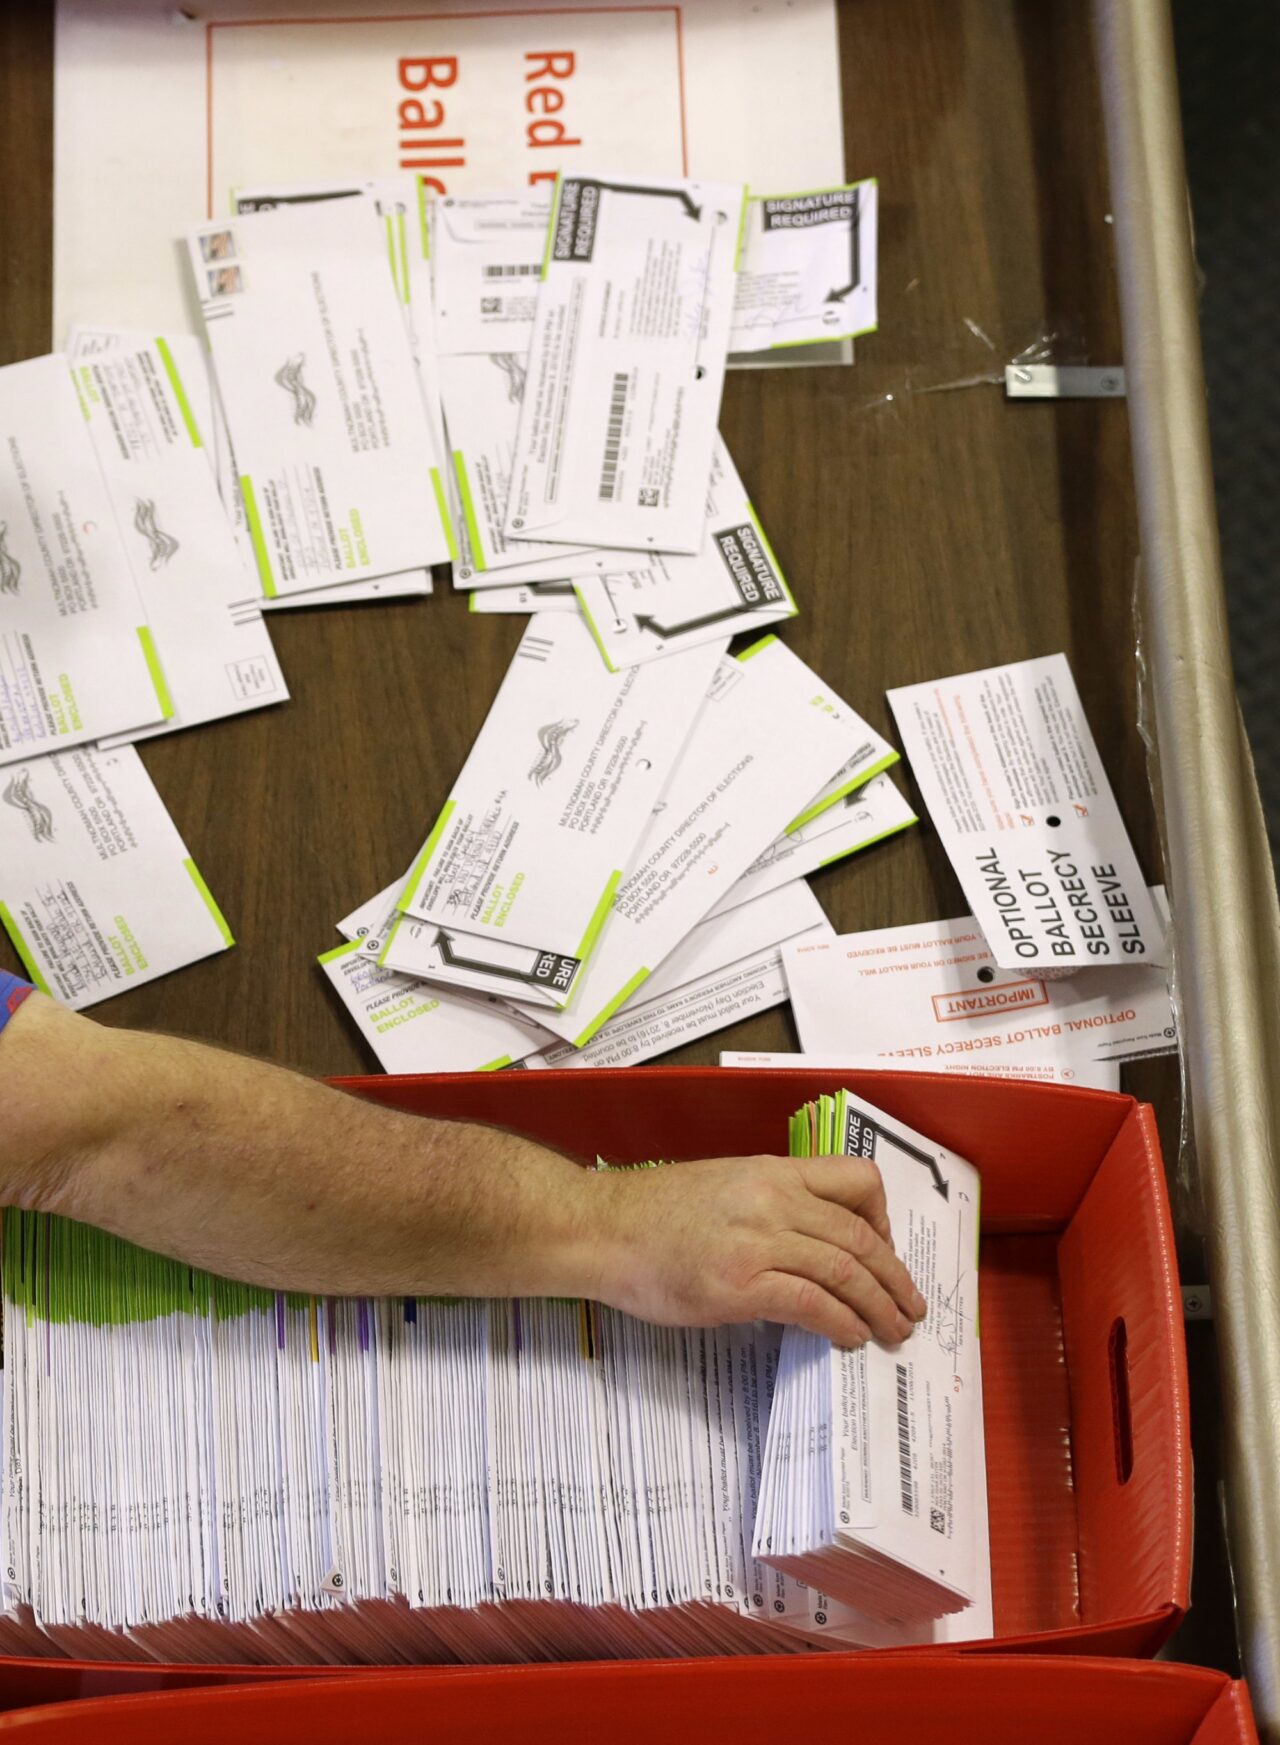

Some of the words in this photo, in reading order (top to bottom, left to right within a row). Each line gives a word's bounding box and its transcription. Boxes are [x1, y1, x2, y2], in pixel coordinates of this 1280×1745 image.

[525, 52, 581, 147] Red
[767, 189, 856, 214] SIGNATURE
[555, 182, 580, 258] SIGNATURE
[574, 186, 597, 256] REQUIRED
[771, 205, 852, 228] REQUIRED
[719, 533, 760, 604] REQUIRED
[736, 525, 780, 601] SIGNATURE
[58, 673, 82, 730] ENCLOSED
[49, 693, 68, 734] BALLOT
[559, 778, 586, 826] MULTNOMAH
[582, 746, 601, 778] COUNTY
[596, 707, 619, 746] DIRECTOR
[614, 696, 624, 708] OF
[620, 662, 640, 696] ELECTIO
[569, 817, 579, 829] PO
[574, 800, 587, 817] BOX
[578, 790, 602, 832] PORTLAND
[598, 778, 608, 790] OR
[647, 835, 676, 866] COUNTY
[674, 800, 709, 837] DIRECTOR
[706, 790, 718, 802] OF
[716, 752, 753, 792] ELECTIONS
[470, 898, 484, 920] PLEASE
[480, 872, 495, 897] PROVIDE
[492, 848, 506, 872] RETURN
[503, 820, 519, 848] ADDRESS
[480, 883, 504, 924] BALLOT
[493, 871, 526, 928] ENCLOSED
[616, 901, 629, 913] PO
[626, 885, 643, 903] BOX
[624, 879, 661, 919] PORTLAND
[658, 869, 671, 882] OR
[975, 847, 1039, 958] OPTIONAL
[1046, 848, 1110, 956] SECRECY
[1017, 869, 1075, 957] BALLOT
[1091, 863, 1146, 955] SLEEVE
[113, 914, 148, 969] ENCLOSED
[898, 942, 920, 951] MUST
[921, 937, 952, 947] BALLOT
[953, 933, 974, 942] YOUR
[107, 933, 135, 975] BALLOT
[846, 946, 884, 958] RECEIVED
[946, 954, 975, 964] SIGNED
[858, 968, 876, 976] WILL
[878, 963, 908, 973] BALLOT
[910, 960, 931, 969] YOUR
[365, 995, 390, 1011] PLEASE
[391, 982, 420, 999] PROVIDE
[714, 993, 731, 1006] Day
[731, 980, 765, 999] Election
[740, 992, 761, 1006] Your
[947, 987, 1035, 1013] IMPORTANT
[369, 995, 416, 1023] BALLOT
[376, 998, 440, 1033] ENCLOSED
[670, 1000, 715, 1025] (November
[697, 1010, 717, 1025] must
[718, 1001, 741, 1016] ballot
[684, 1019, 697, 1031] be
[1064, 1009, 1136, 1031] OPTIONAL
[626, 1033, 636, 1043] to
[635, 1023, 660, 1040] 2016)
[650, 1025, 685, 1045] received
[1006, 1024, 1061, 1044] BALLOT
[615, 1038, 627, 1049] be
[619, 1043, 639, 1058] 8:00
[638, 1038, 650, 1049] by
[877, 1046, 933, 1058] SLEE
[934, 1035, 1001, 1056] SECRECY
[592, 1058, 604, 1067] on
[604, 1051, 620, 1064] PM
[740, 1347, 746, 1357] on
[740, 1359, 747, 1373] PM
[840, 1362, 846, 1371] be
[847, 1354, 856, 1398] (November
[741, 1375, 749, 1393] 8:00
[742, 1395, 750, 1405] by
[840, 1396, 848, 1416] ballot
[743, 1406, 752, 1440] received
[841, 1419, 849, 1436] Your
[746, 1442, 753, 1452] be
[748, 1476, 756, 1498] ballot
